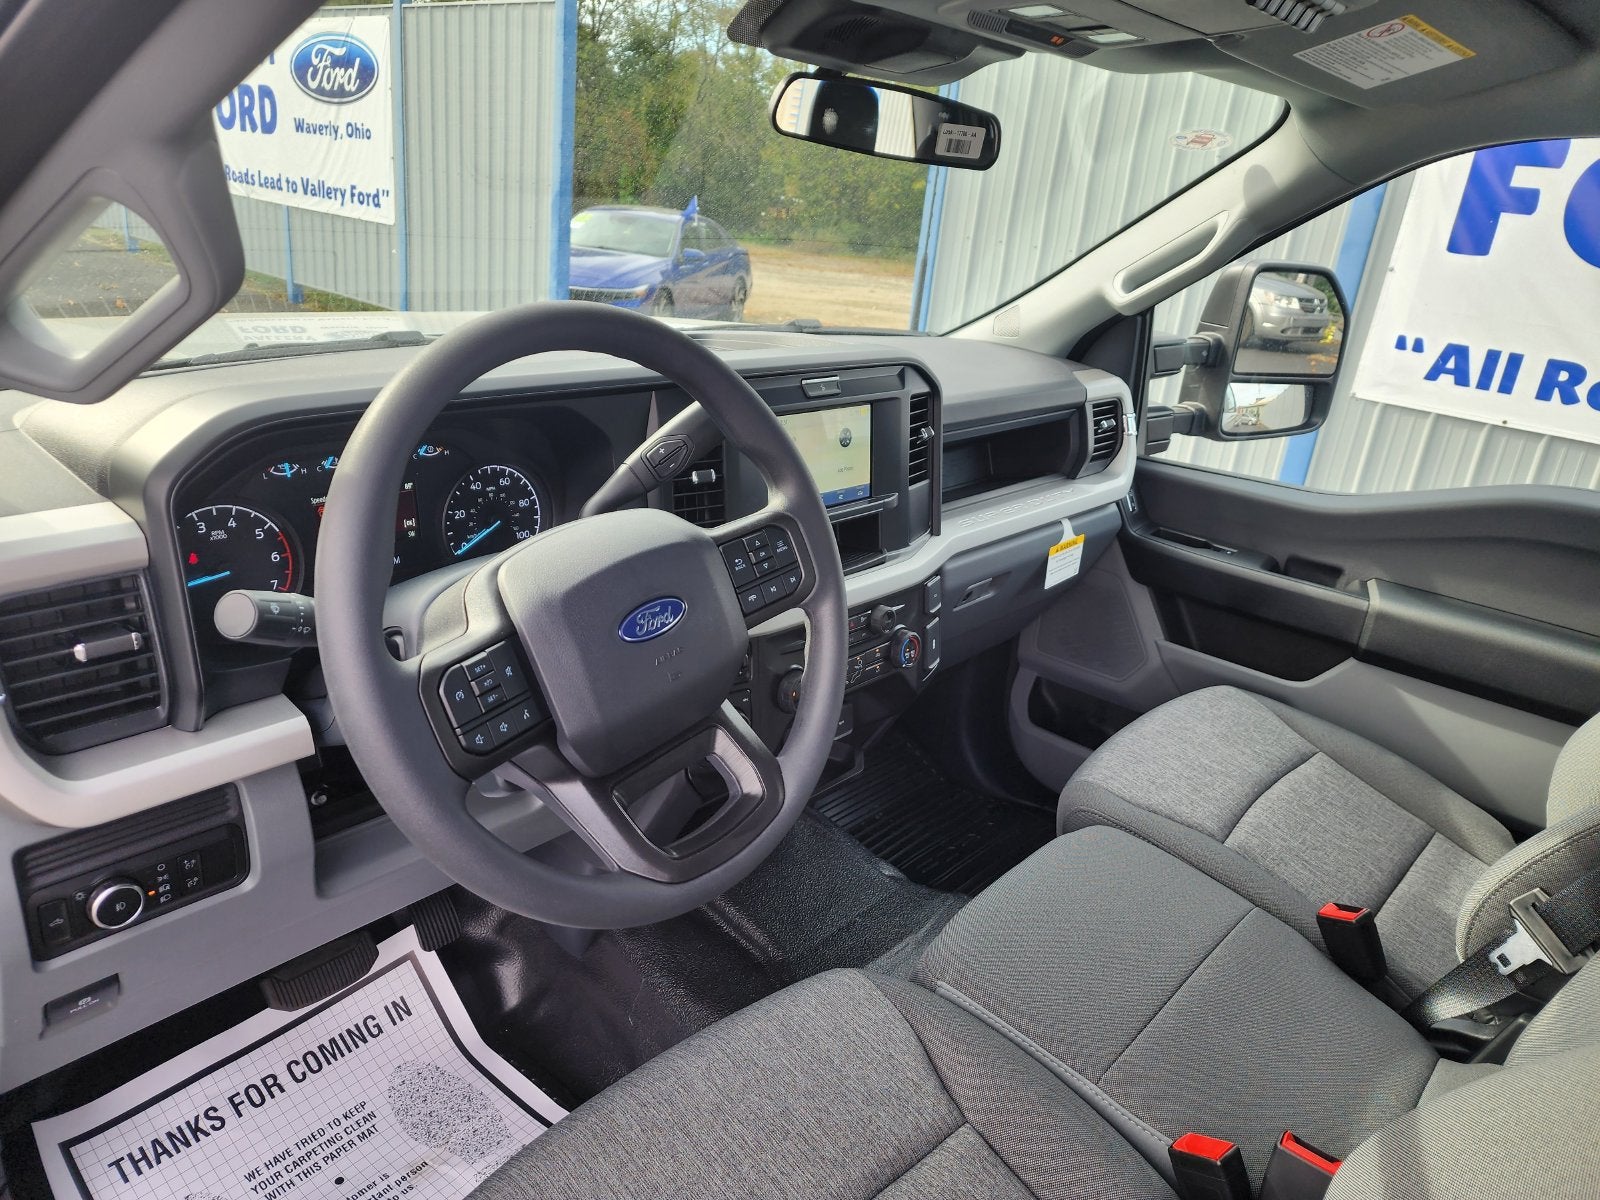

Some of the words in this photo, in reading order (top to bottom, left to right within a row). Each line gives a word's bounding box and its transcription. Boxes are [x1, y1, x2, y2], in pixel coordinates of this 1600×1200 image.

[307, 43, 361, 92] Ford
[294, 117, 343, 141] Waverly,
[346, 122, 372, 140] Ohio
[258, 170, 283, 192] Lead
[285, 176, 298, 194] to
[300, 177, 347, 207] Vallery
[262, 472, 268, 480] L
[499, 477, 511, 486] 60
[470, 481, 481, 491] 40
[518, 498, 530, 507] 80
[454, 509, 466, 519] 20
[196, 522, 207, 533] 3
[227, 517, 237, 528] 4
[255, 528, 265, 539] 5
[515, 530, 530, 540] 100
[271, 551, 280, 562] 6
[270, 579, 279, 590] 7
[636, 605, 674, 636] Ford
[108, 1106, 226, 1185] THANKS
[228, 1073, 285, 1118] FOR
[286, 1014, 384, 1084] COMING
[384, 996, 413, 1026] IN
[244, 1166, 263, 1183] WE
[264, 1148, 294, 1171] HAVE
[294, 1127, 326, 1150] TRIED
[327, 1117, 342, 1131] TO
[342, 1100, 367, 1122] KEEP
[250, 1171, 284, 1196] YOUR
[284, 1131, 344, 1174] CARPETING
[344, 1110, 377, 1136] CLEAN
[264, 1179, 295, 1200] WITH
[295, 1162, 322, 1182] THIS
[322, 1139, 357, 1166] PAPER
[357, 1124, 380, 1143] MAT
[379, 1172, 390, 1182] is
[394, 1160, 428, 1187] person
[401, 1184, 418, 1195] us.
